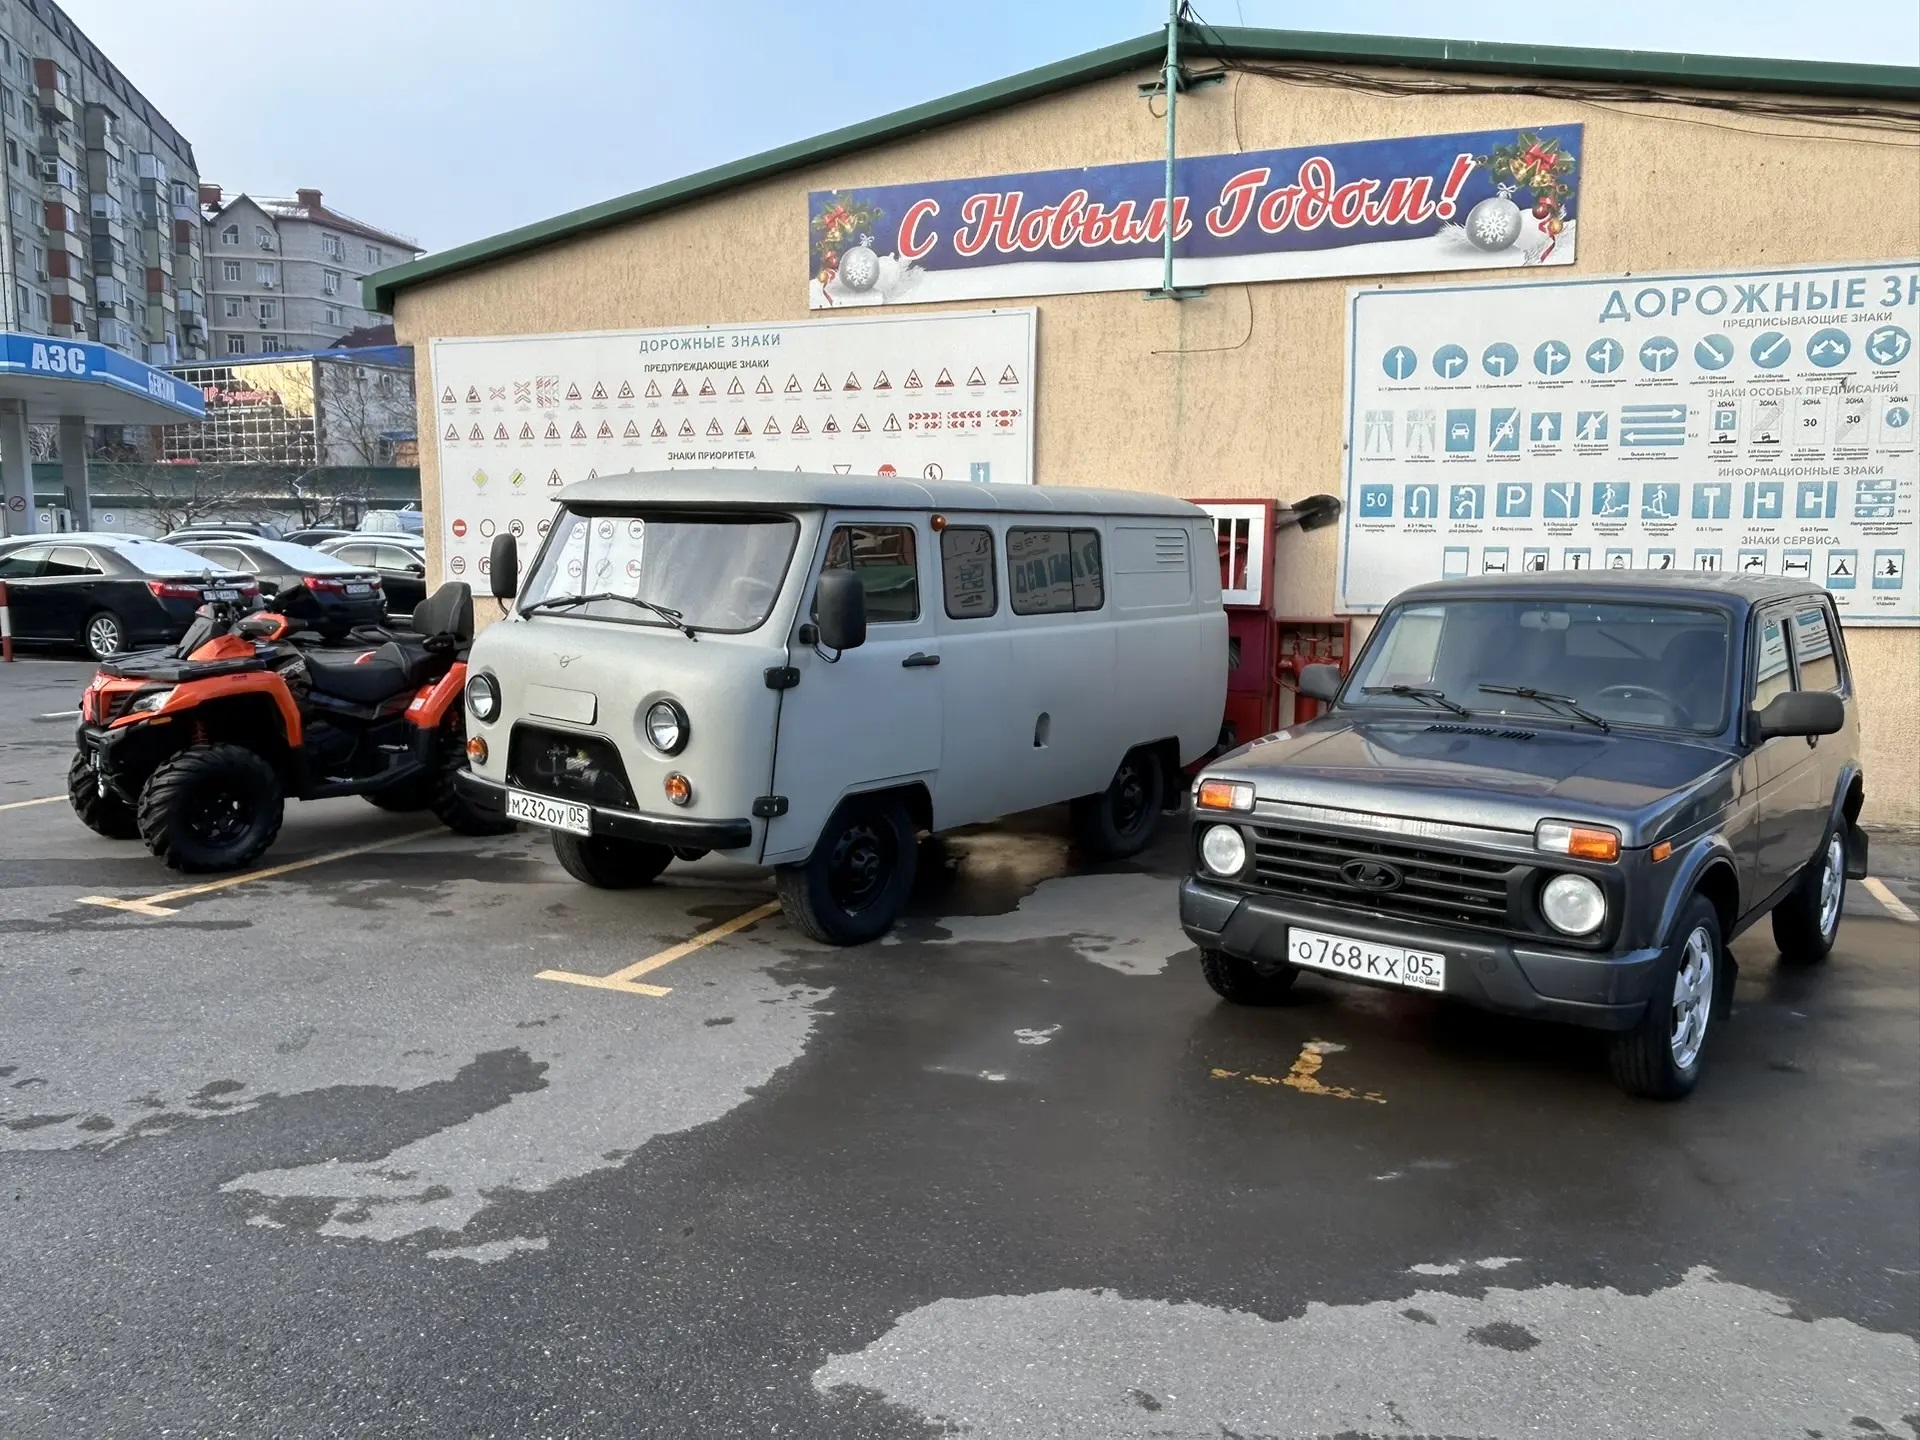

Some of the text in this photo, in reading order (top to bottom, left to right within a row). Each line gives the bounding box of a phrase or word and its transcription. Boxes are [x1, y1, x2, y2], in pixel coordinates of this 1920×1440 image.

[898, 153, 1476, 260] С Новым Годом!
[1598, 277, 1867, 324] ДОРОЖНЫЕ
[1722, 311, 1893, 329] ПРЕДПИСЫВАЮЩИЕ ЗНАКИ
[639, 333, 781, 354] ДОРОЖНЫЕ ЗНАКИ
[31, 342, 86, 375] АЗС
[644, 359, 769, 374] ПРЕДУПРЕЖДАЮЩИЕ ЗНАКИ
[1707, 381, 1899, 398] ЗНАКИ ОСОБЫХ ПРЕДПИСАНИЙ
[1803, 418, 1817, 427] 30
[1846, 415, 1860, 424] 30
[668, 451, 756, 460] ЗНАКИ ПРИОРИТЕТА
[1718, 465, 1884, 477] ИНФОРМАЦИОННЫЕ ЗНАКИ
[1366, 493, 1388, 507] 50
[1741, 535, 1840, 545] ЗНАКИ СЕРВИСА
[569, 807, 584, 824] 05
[1407, 955, 1433, 977] 05
[1404, 972, 1424, 984] RUS
